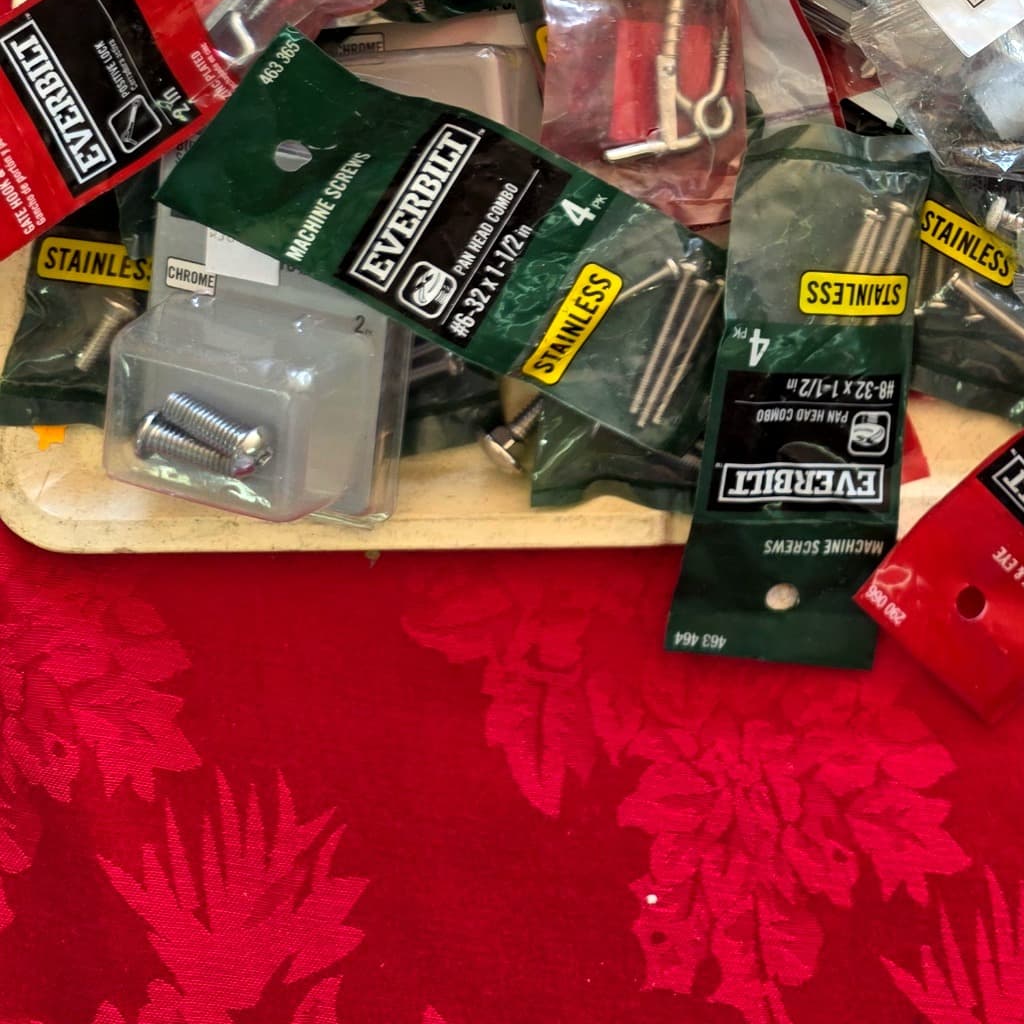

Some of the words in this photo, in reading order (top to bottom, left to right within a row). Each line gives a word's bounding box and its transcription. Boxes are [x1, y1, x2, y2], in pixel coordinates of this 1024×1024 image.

[93, 39, 113, 63] LOCK
[258, 60, 284, 87] 463
[279, 39, 301, 64] 365
[104, 60, 132, 98] POSITIVE
[12, 34, 107, 173] EVERBILT
[285, 199, 335, 263] MACHINE
[327, 151, 373, 202] SCREWS
[361, 130, 469, 283] EVERBILT
[559, 198, 596, 227] 4
[593, 194, 609, 211] PK
[454, 247, 477, 277] PAN
[472, 220, 494, 254] HEAD
[487, 182, 519, 224] COMBO
[921, 210, 1012, 279] STAINLESS
[168, 265, 215, 289] CHROME
[450, 284, 491, 339] #6-32
[484, 277, 500, 292] x
[494, 235, 523, 278] 1-1/2
[518, 224, 534, 244] in
[806, 280, 901, 306] STAINLESS
[533, 273, 613, 374] STAINLESS
[732, 328, 748, 340] PK
[748, 328, 770, 367] 4
[786, 377, 798, 393] in
[799, 378, 839, 399] 1-1/2
[843, 382, 854, 397] x
[854, 378, 896, 400] #8-32
[756, 408, 794, 423] COMBO
[796, 408, 824, 423] HEAD
[825, 409, 849, 424] PAN
[728, 468, 877, 497] EVERBILT
[763, 538, 819, 555] SCREWS
[823, 538, 884, 556] MACHINE
[990, 544, 1019, 572] EYE
[882, 601, 908, 627] 290
[674, 630, 701, 648] 464
[702, 633, 727, 649] 463
